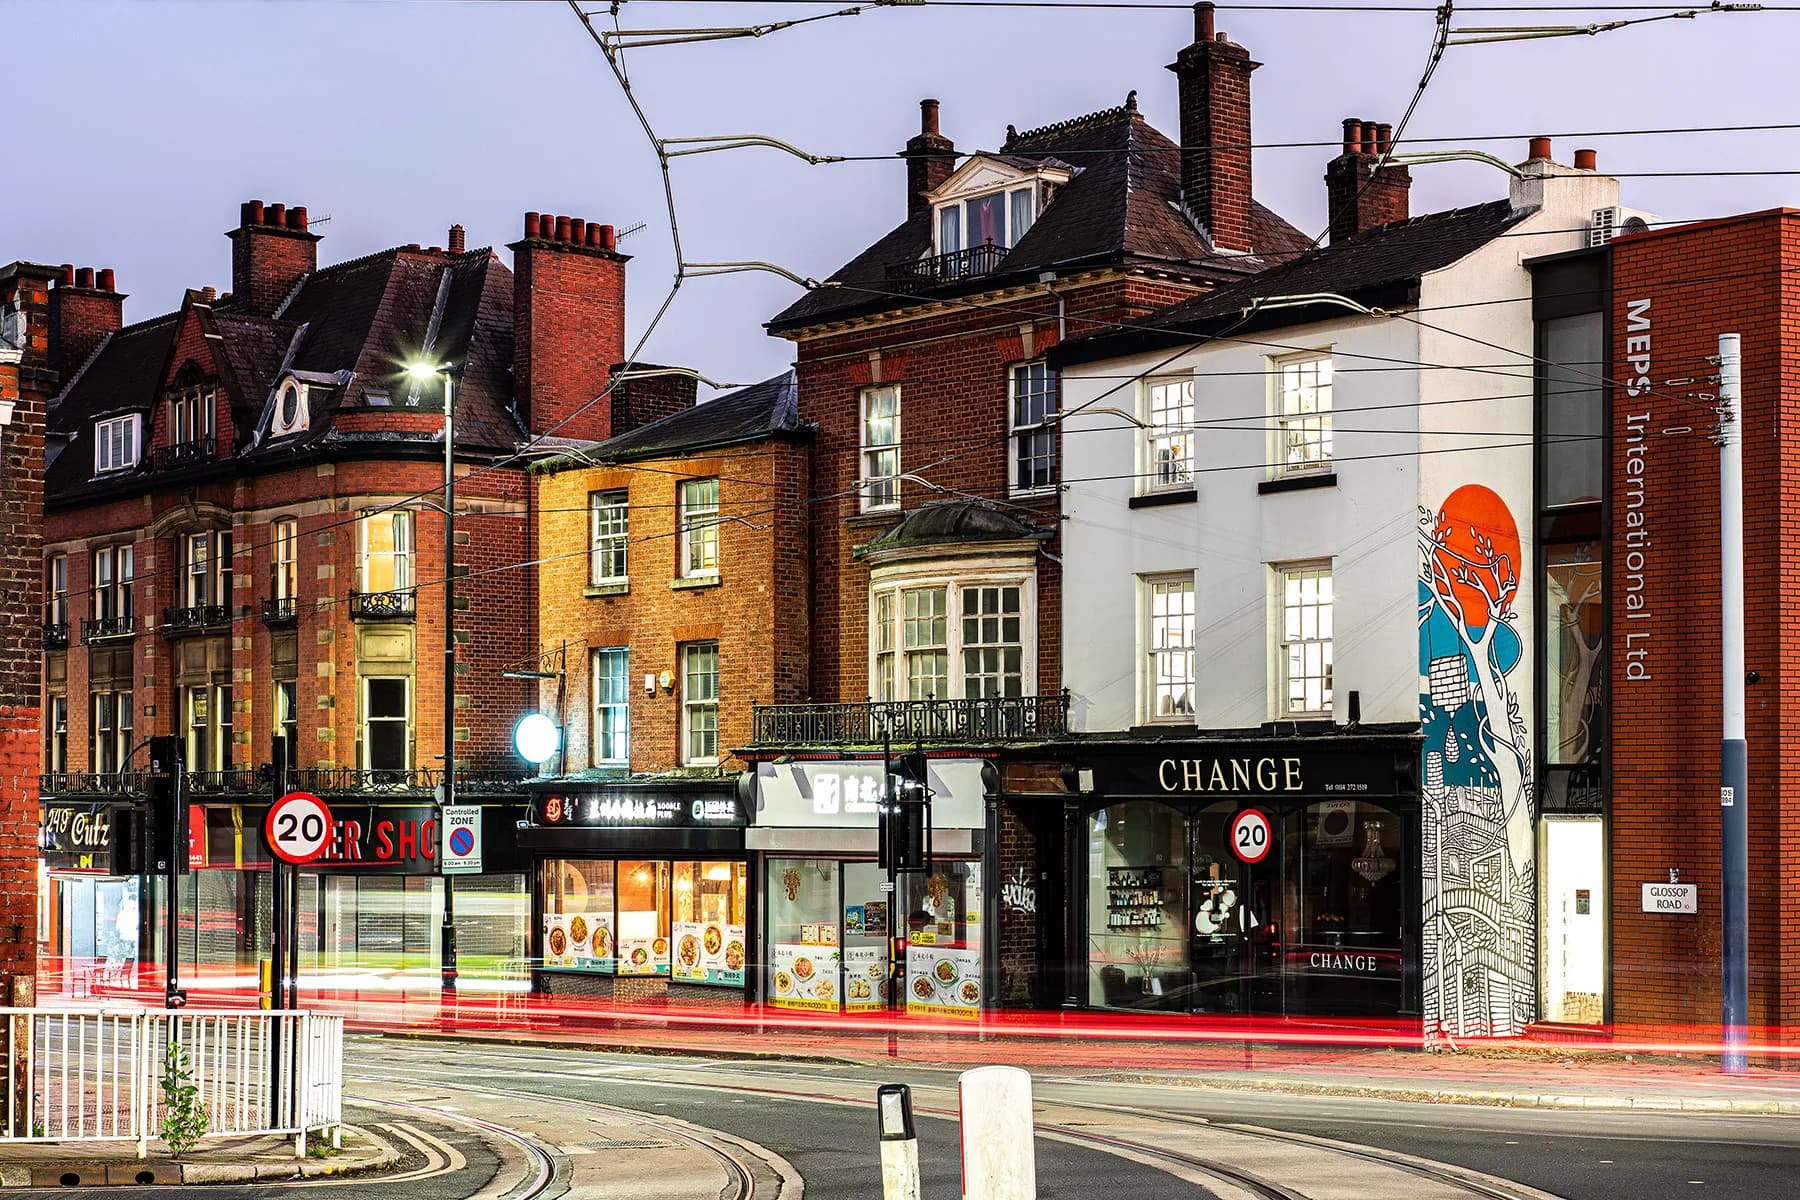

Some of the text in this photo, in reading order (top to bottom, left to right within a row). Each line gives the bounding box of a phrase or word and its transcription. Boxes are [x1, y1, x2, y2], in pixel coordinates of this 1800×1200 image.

[1626, 298, 1651, 681] MEPS International Ltd
[1158, 757, 1304, 791] CHANGE
[445, 808, 480, 816] Controlled
[450, 817, 475, 825] ZONE
[46, 808, 111, 846] 249 Cutz
[278, 813, 324, 842] 20
[1238, 824, 1266, 847] 20
[316, 820, 362, 860] ER
[1650, 887, 1689, 897] GLOSSOP
[1656, 900, 1682, 909] ROAD
[1310, 952, 1377, 972] CHANGE
